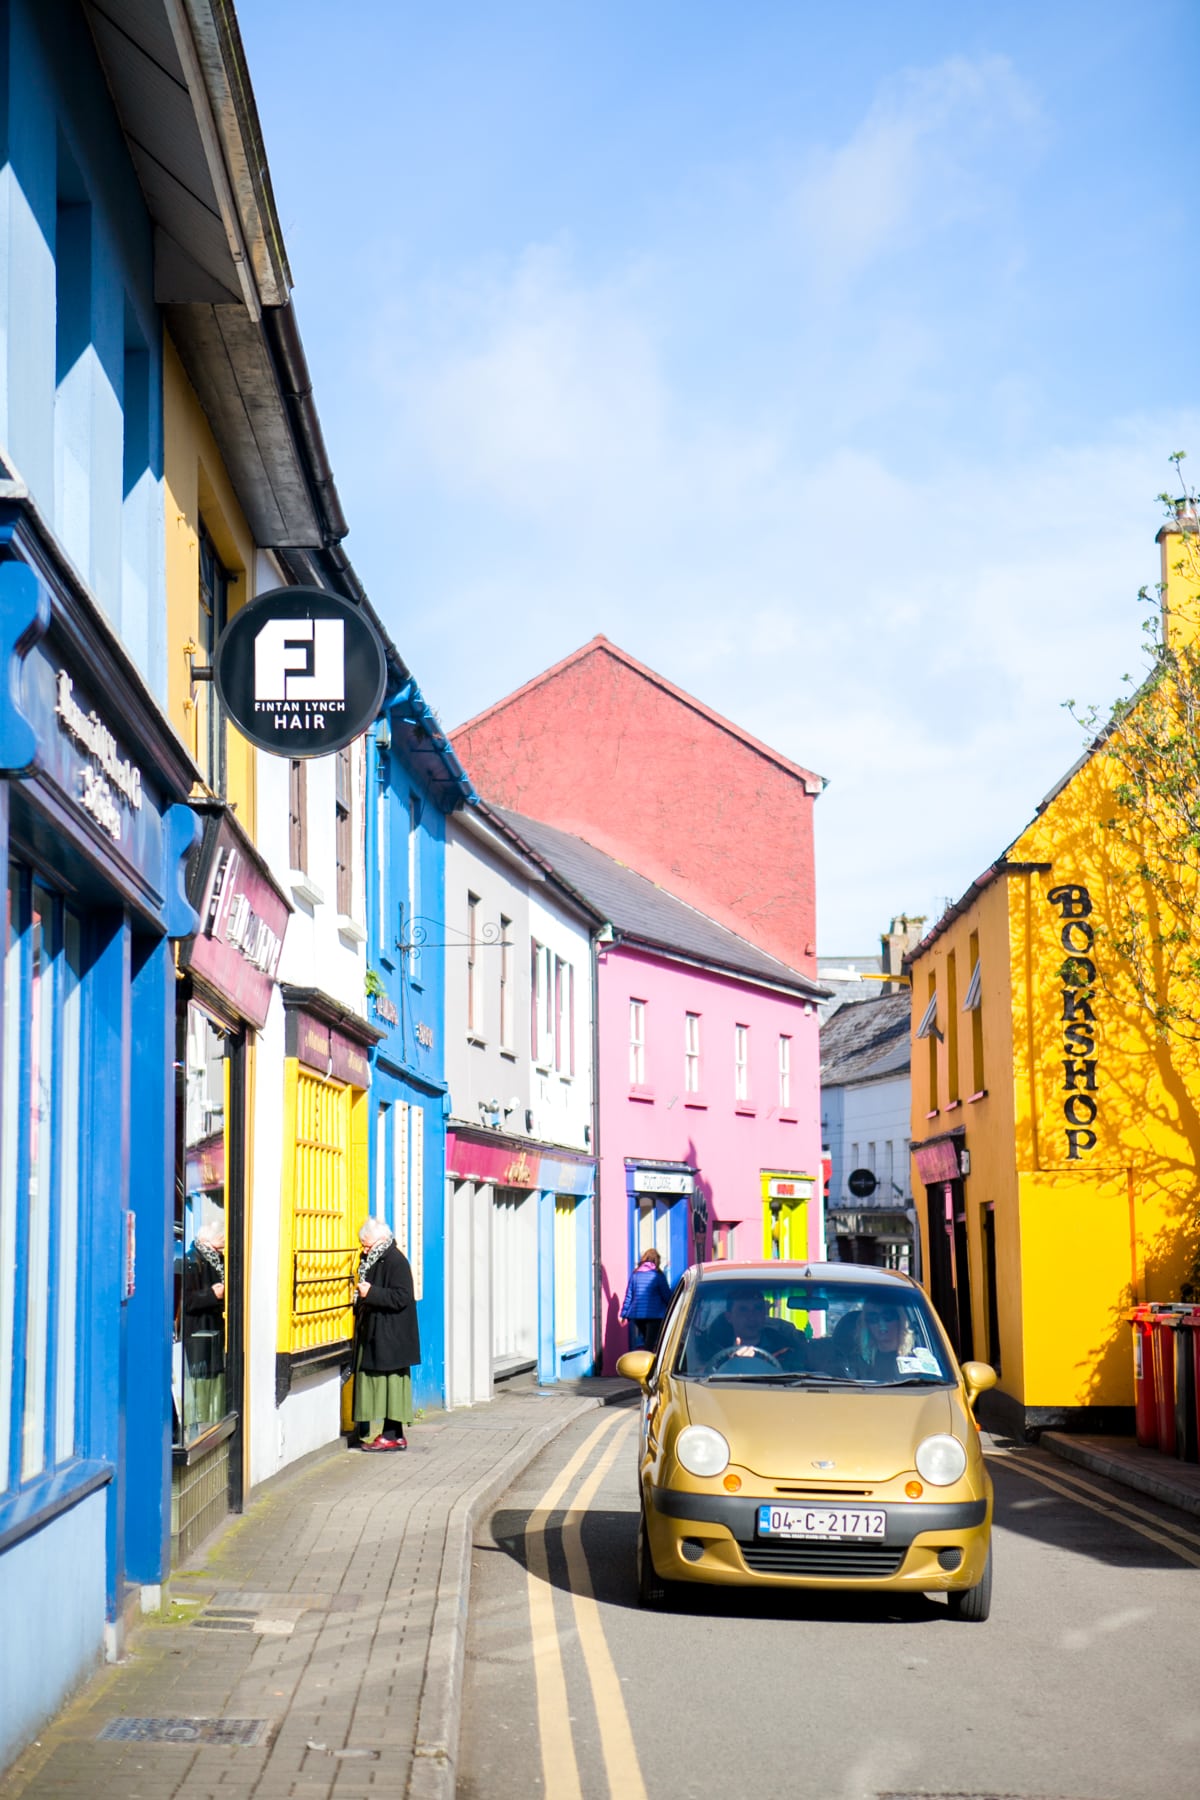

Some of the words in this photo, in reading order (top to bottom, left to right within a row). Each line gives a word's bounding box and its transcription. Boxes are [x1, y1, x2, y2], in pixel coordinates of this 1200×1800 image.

[254, 702, 299, 712] FINTAN
[305, 702, 345, 712] LYNCH
[274, 714, 325, 729] HAIR
[1047, 884, 1099, 1160] BOOKSHOP
[771, 1511, 883, 1534] 04-C-21712
